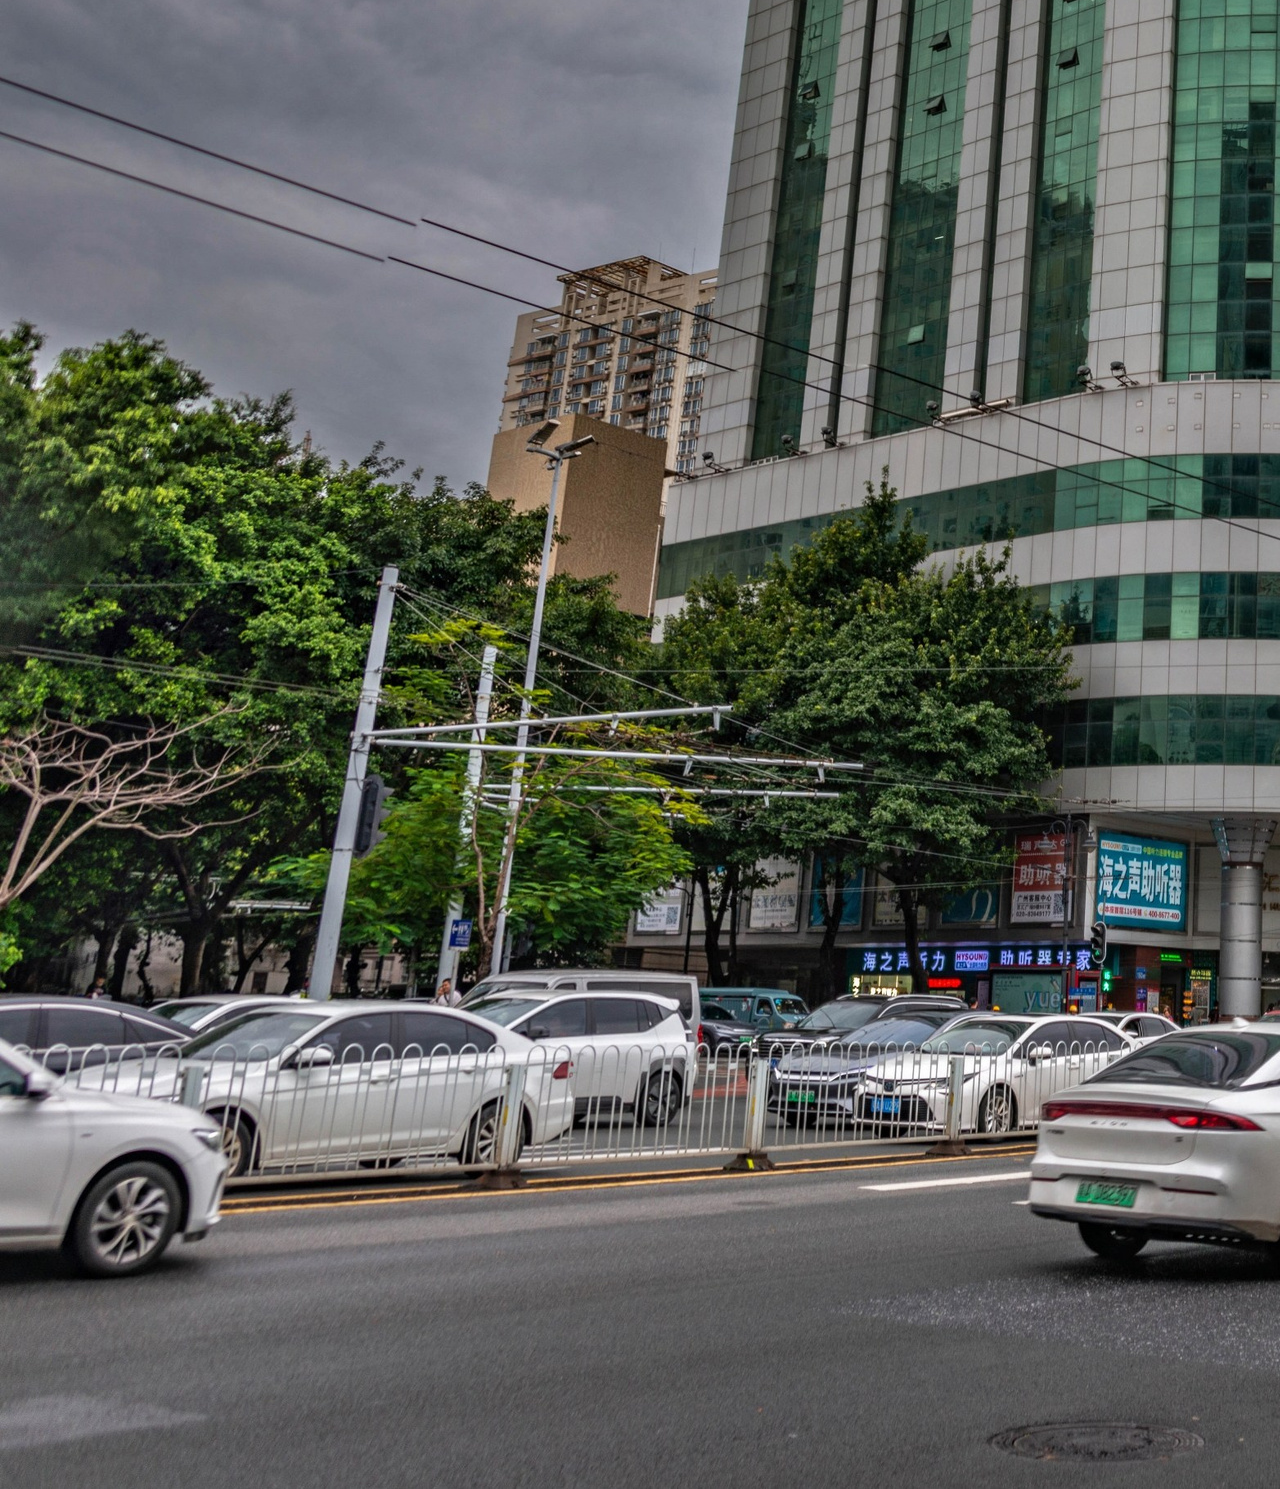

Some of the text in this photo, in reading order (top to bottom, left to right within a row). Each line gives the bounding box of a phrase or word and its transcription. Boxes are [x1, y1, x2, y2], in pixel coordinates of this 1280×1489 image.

[1098, 854, 1183, 906] 海之声助听器
[956, 952, 988, 961] HYSOUND
[1000, 949, 1092, 972] 助听器专家
